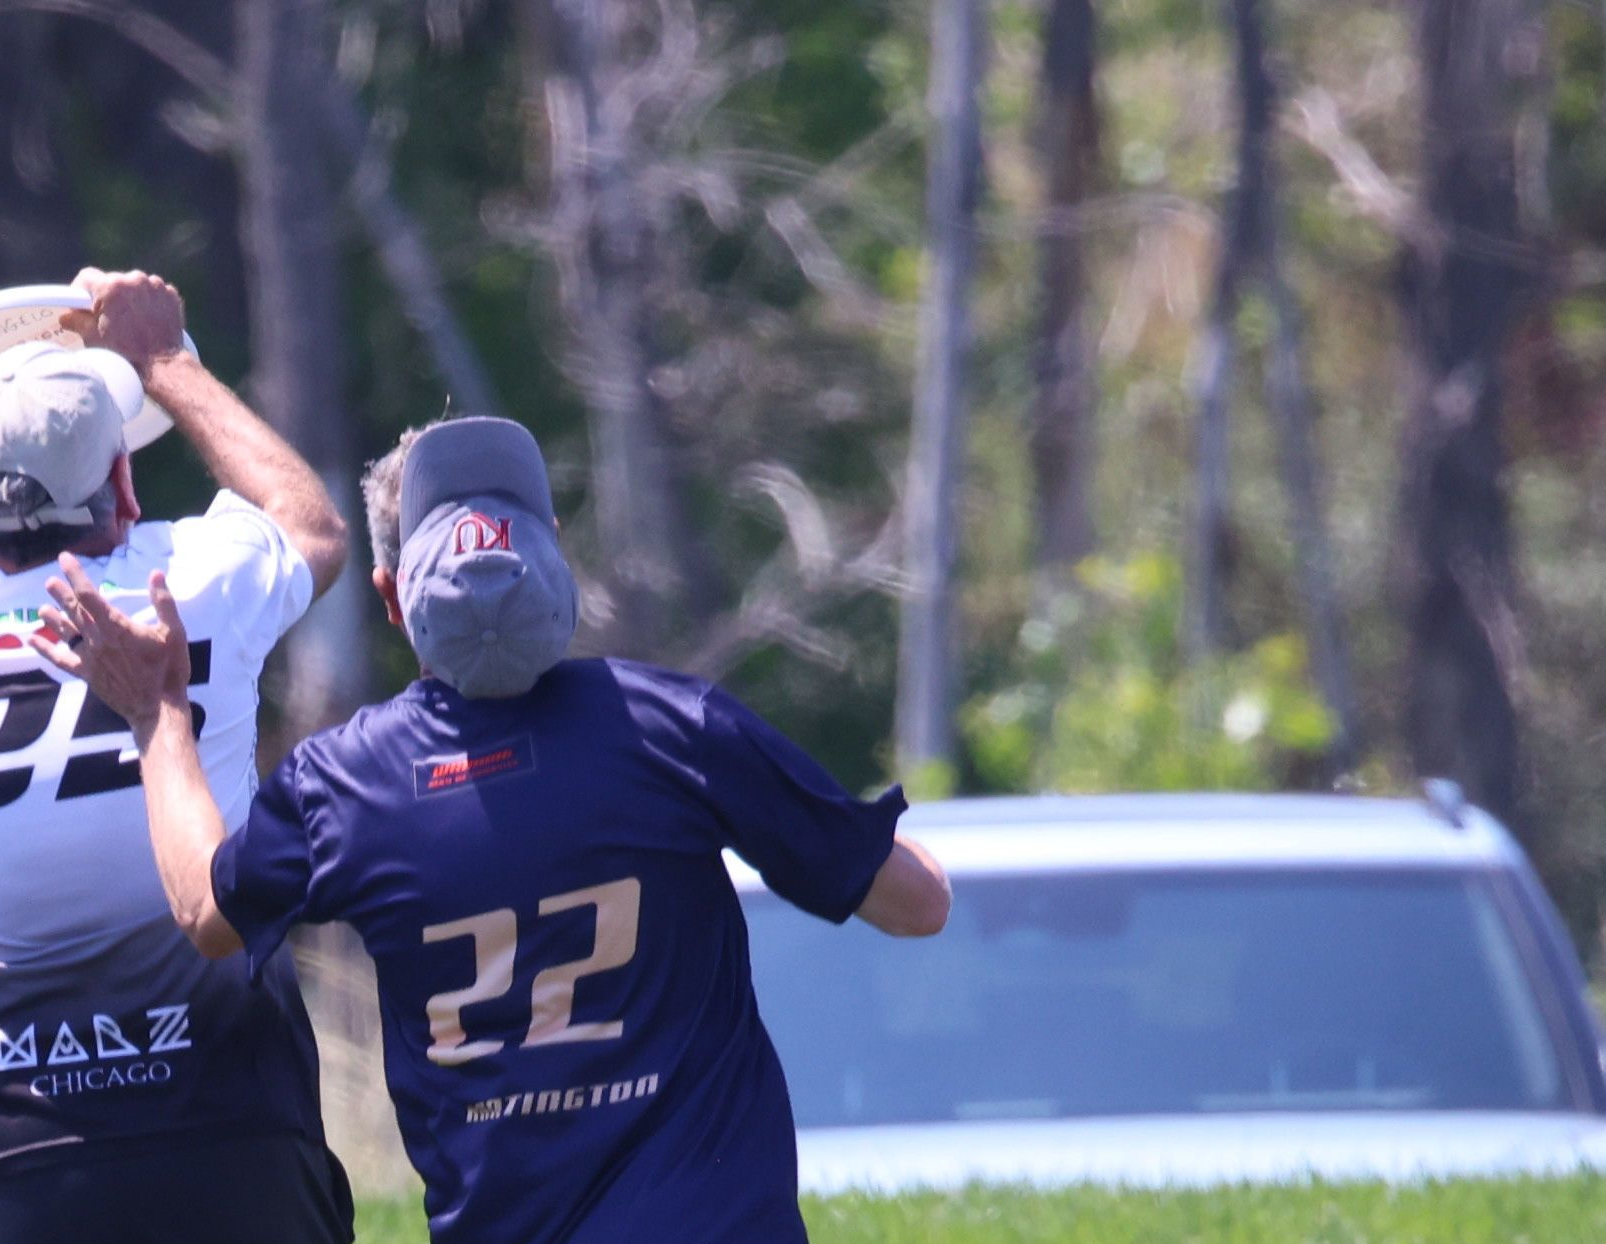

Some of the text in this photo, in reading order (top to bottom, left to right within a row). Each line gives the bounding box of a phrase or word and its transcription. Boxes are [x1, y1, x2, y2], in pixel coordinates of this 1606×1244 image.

[453, 511, 514, 557] KU
[422, 876, 642, 1067] 22
[29, 1060, 172, 1098] CHICAGO
